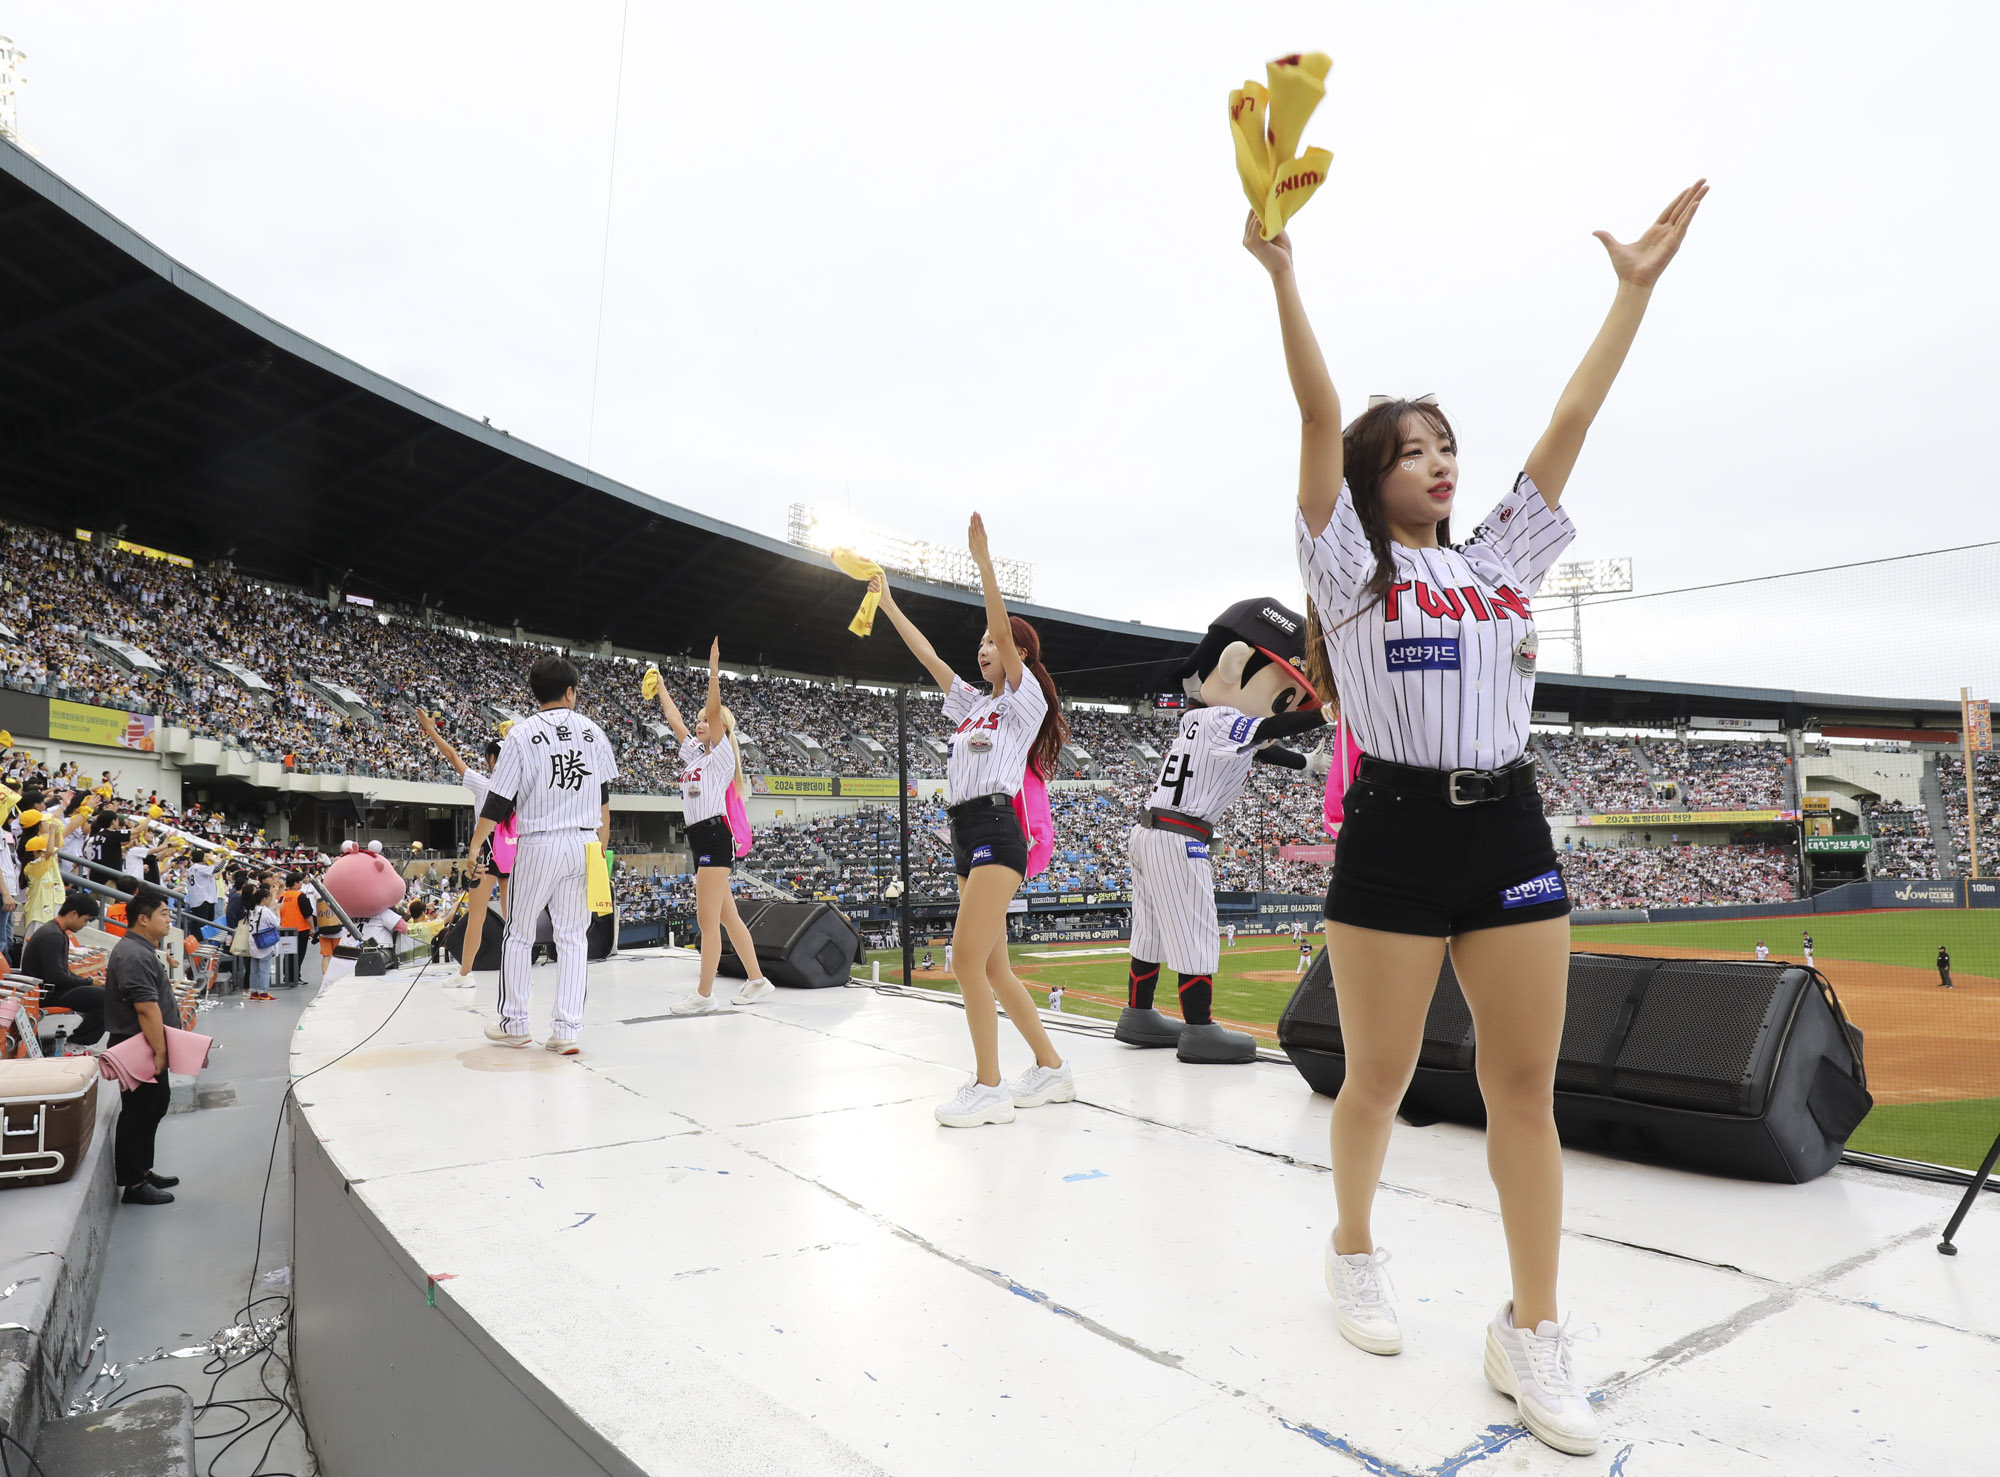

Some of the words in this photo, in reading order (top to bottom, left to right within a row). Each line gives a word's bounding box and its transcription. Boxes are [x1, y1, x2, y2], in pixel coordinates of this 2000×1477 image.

[1262, 606, 1297, 633] 신한카드
[1388, 645, 1457, 664] 신한카드
[1233, 714, 1252, 740] 신한카
[549, 749, 593, 792] 勝
[774, 781, 794, 791] 2024
[1154, 753, 1194, 807] 타
[1605, 815, 1630, 824] 2024
[1808, 840, 1870, 850] 대신정보통신
[1505, 876, 1562, 901] 신한카드
[1972, 884, 1996, 893] 100m
[1031, 895, 1057, 904] mentos
[1260, 904, 1289, 914] 공공기관
[1291, 904, 1322, 912] 이사가자!
